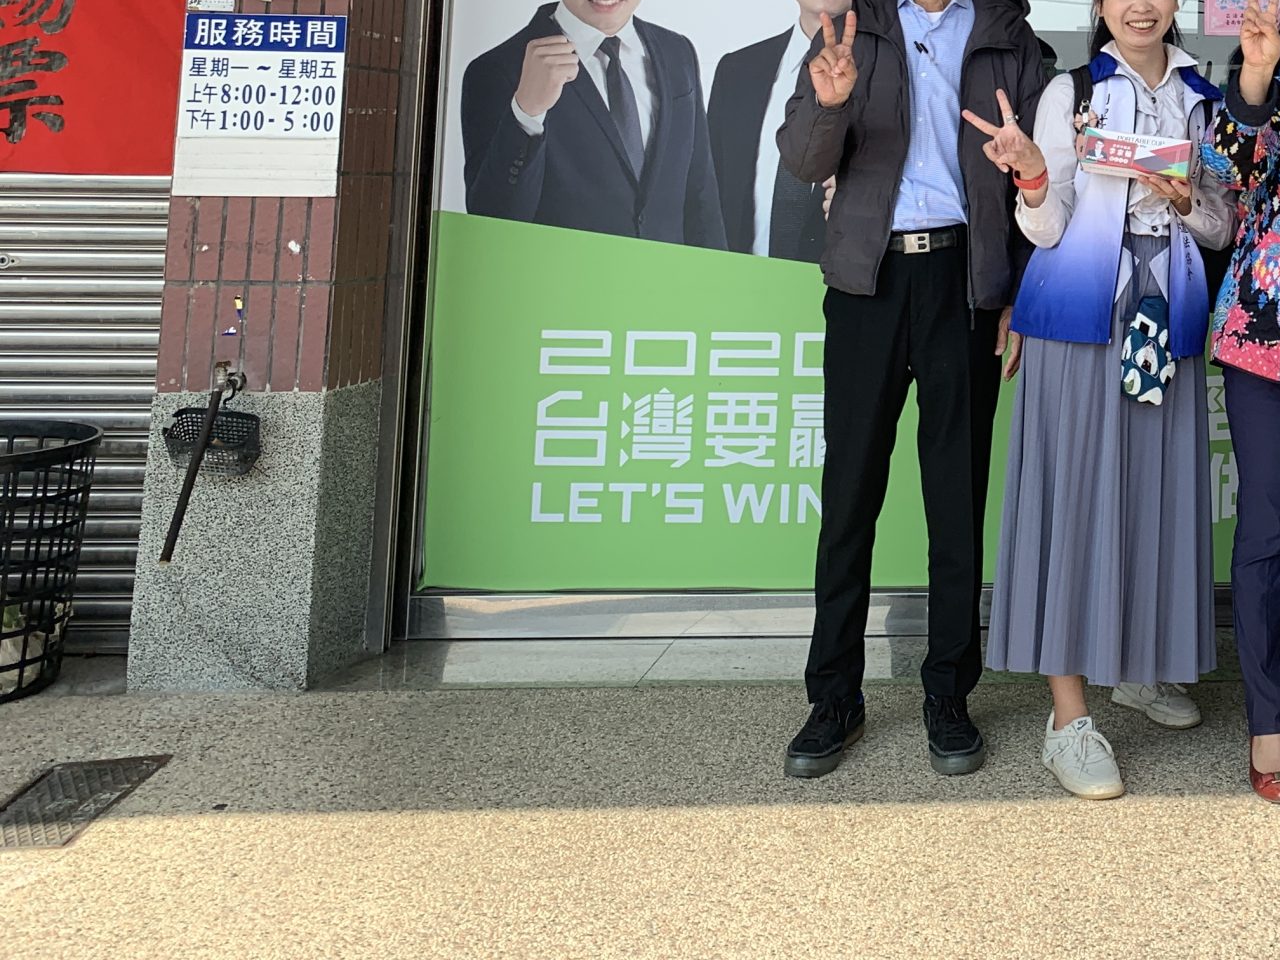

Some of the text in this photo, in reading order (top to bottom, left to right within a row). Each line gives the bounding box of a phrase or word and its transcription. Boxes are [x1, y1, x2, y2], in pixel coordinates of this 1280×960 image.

[194, 18, 337, 48] 服務時間
[530, 482, 822, 523] LET'S WIN
